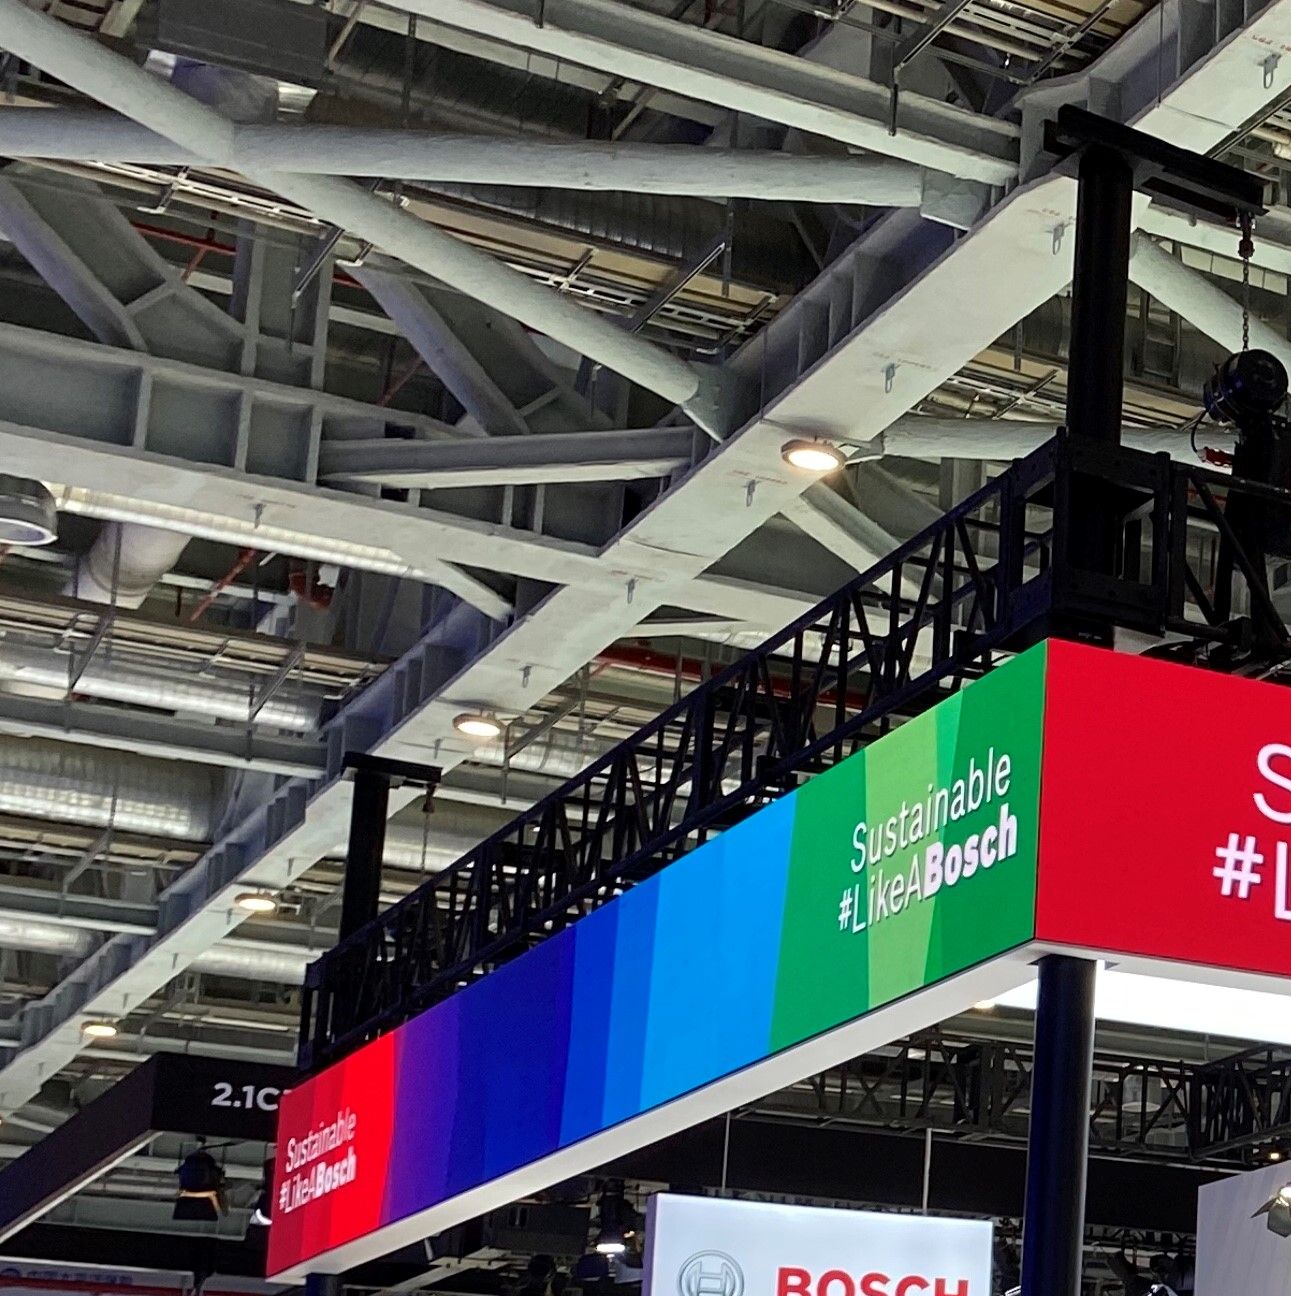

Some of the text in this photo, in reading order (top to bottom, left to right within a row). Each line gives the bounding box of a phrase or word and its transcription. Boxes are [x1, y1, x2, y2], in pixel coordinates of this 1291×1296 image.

[850, 746, 1011, 873] Sustainable
[838, 803, 1017, 934] #LikeABosch
[210, 1082, 292, 1111] 2.1C
[285, 1106, 357, 1173] Sustainable
